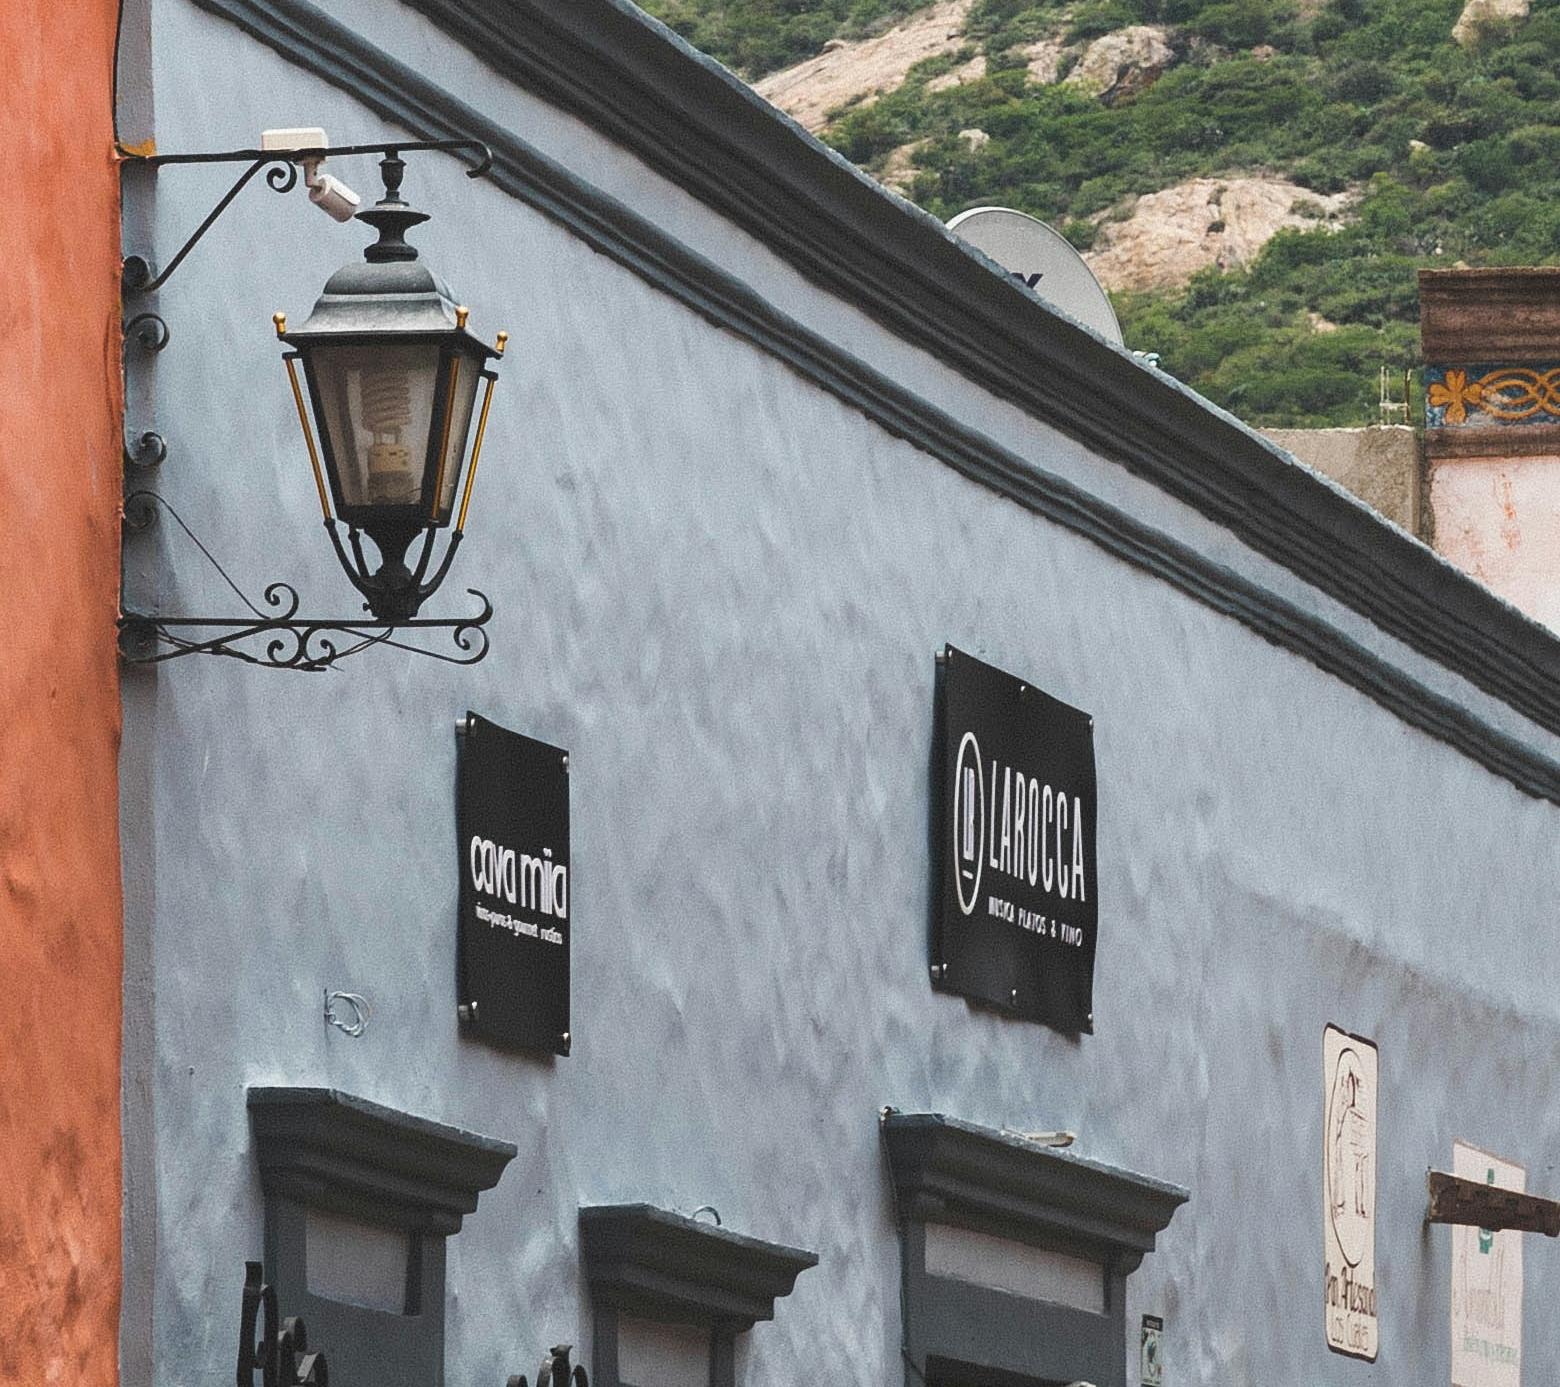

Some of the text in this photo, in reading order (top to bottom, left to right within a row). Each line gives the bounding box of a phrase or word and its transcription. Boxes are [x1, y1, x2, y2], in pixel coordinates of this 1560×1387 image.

[989, 759, 1086, 903] LAROCCA
[470, 835, 517, 904] cava
[1018, 907, 1047, 935] PLATOS
[1050, 919, 1057, 938] &
[1060, 922, 1083, 947] VINO
